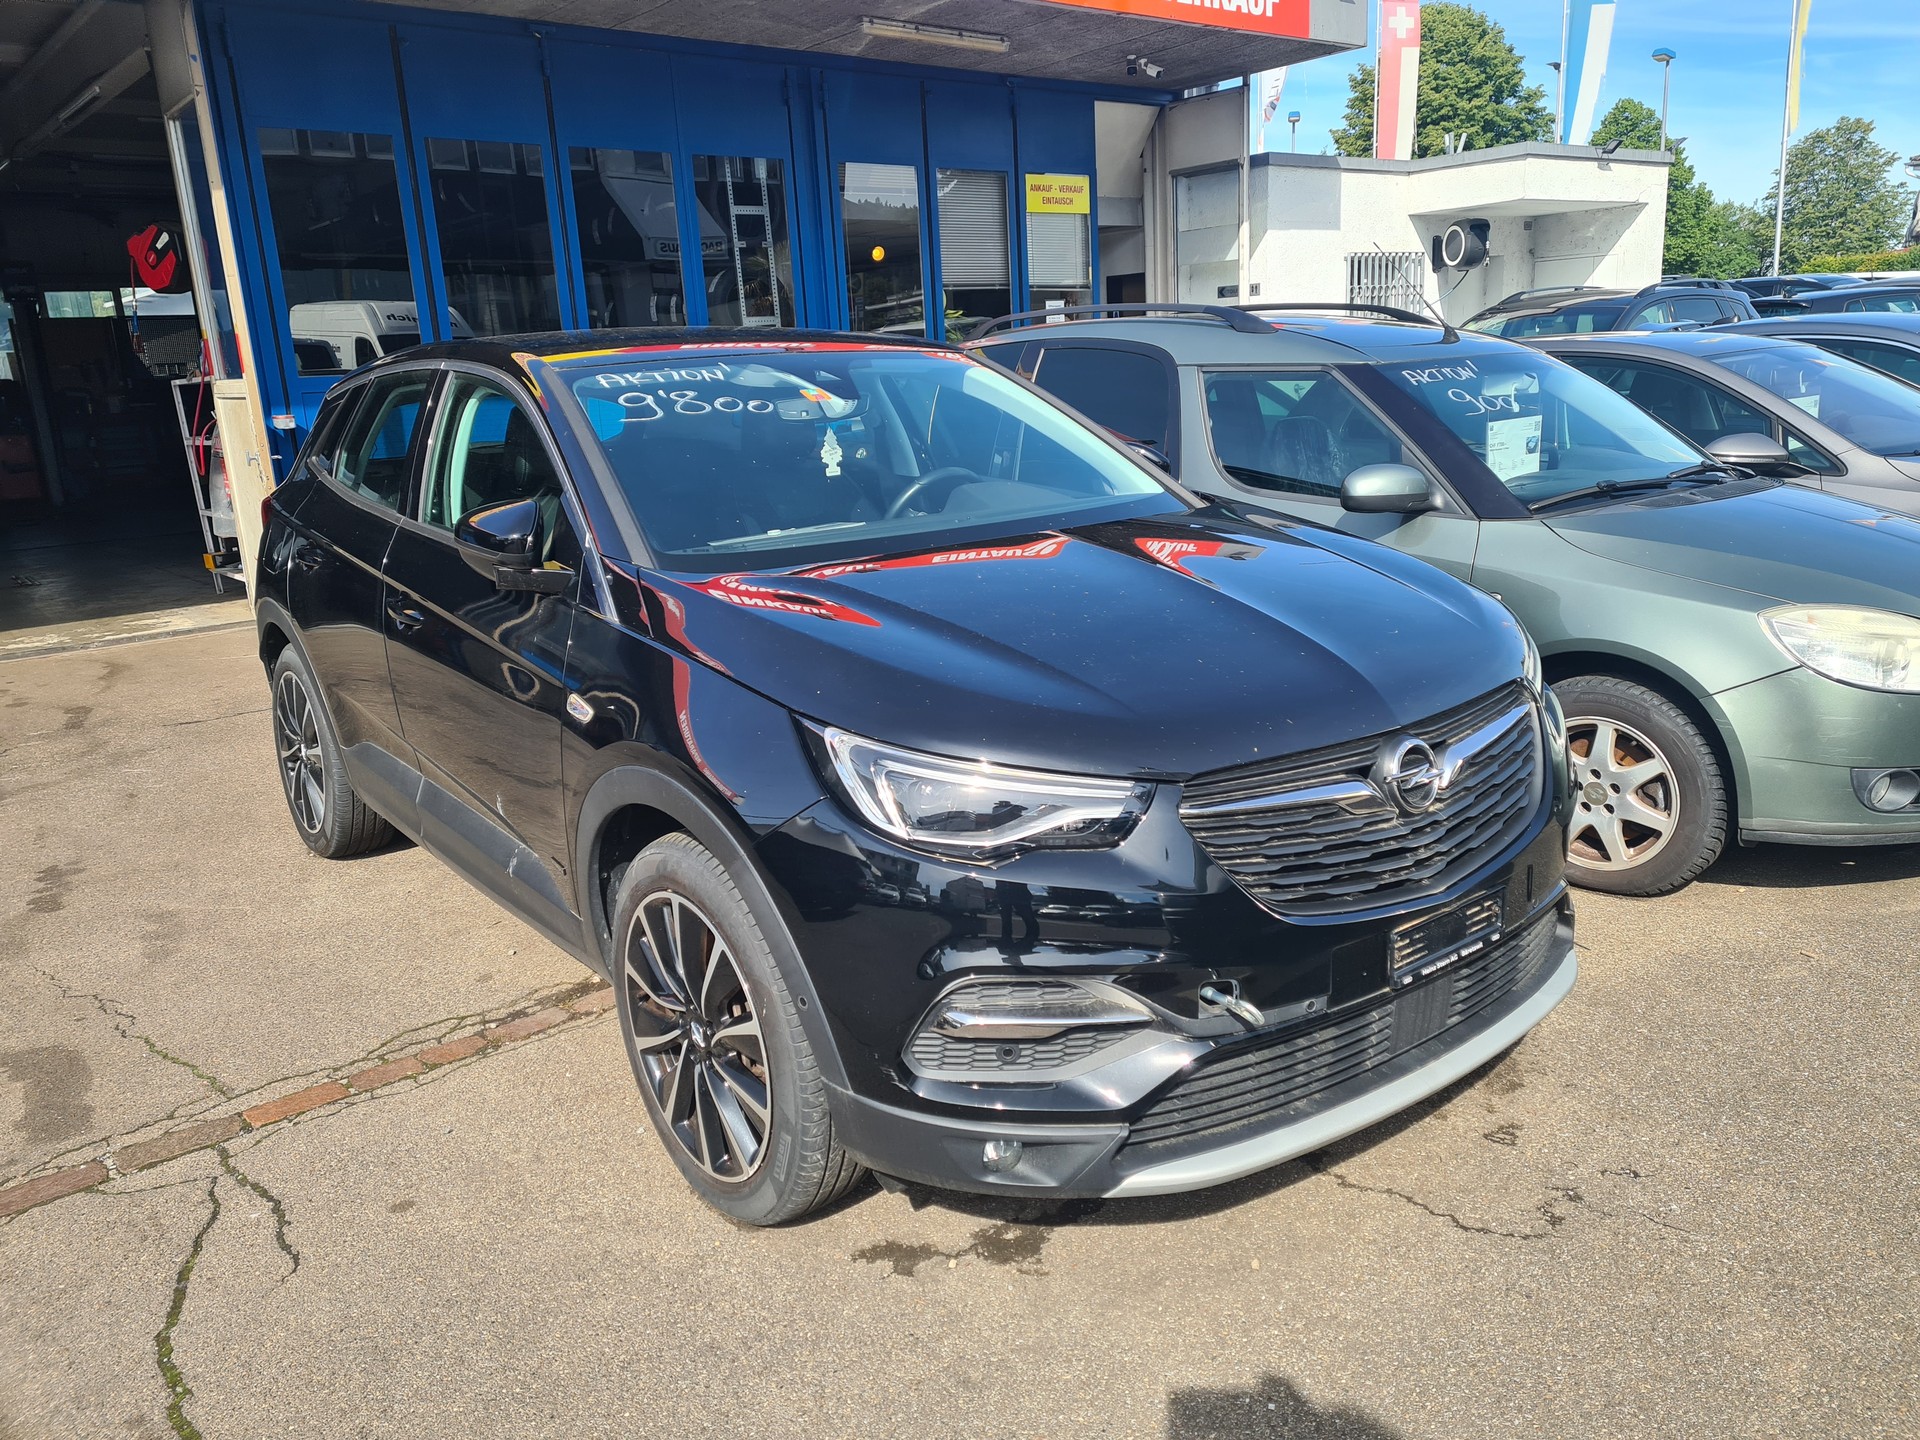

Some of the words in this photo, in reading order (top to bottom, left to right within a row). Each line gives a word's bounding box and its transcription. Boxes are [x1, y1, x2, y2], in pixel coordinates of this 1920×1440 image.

[1030, 184, 1053, 193] ANKAUF
[1059, 185, 1084, 194] VERKAUF
[1042, 196, 1073, 205] EINTAUSCH
